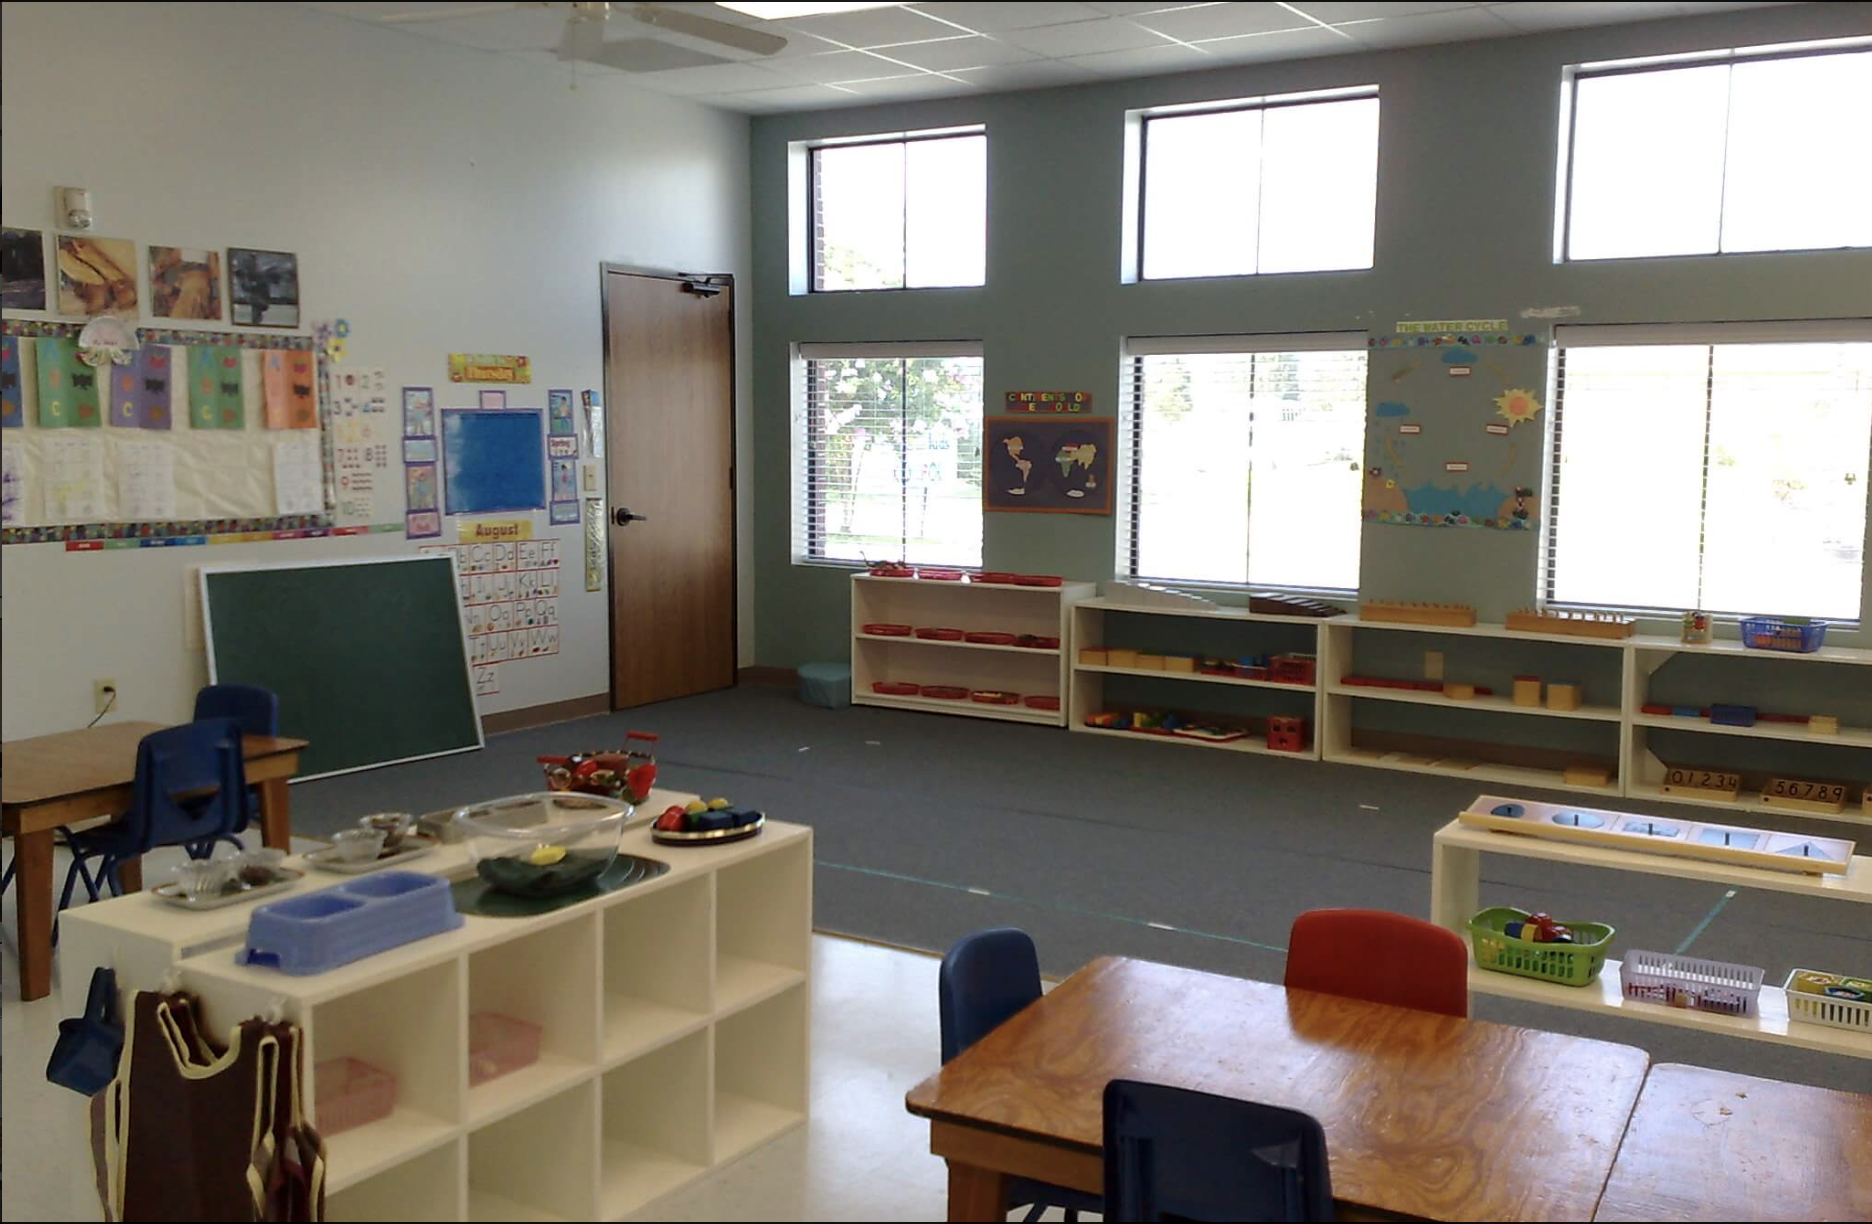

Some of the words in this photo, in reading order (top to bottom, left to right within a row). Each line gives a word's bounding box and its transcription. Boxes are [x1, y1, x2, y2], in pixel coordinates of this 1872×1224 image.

[1398, 323, 1421, 333] THE
[1423, 322, 1463, 332] WATER
[1466, 321, 1509, 332] CYCLE
[51, 400, 61, 417] C
[122, 400, 134, 418] C
[476, 523, 519, 539] August
